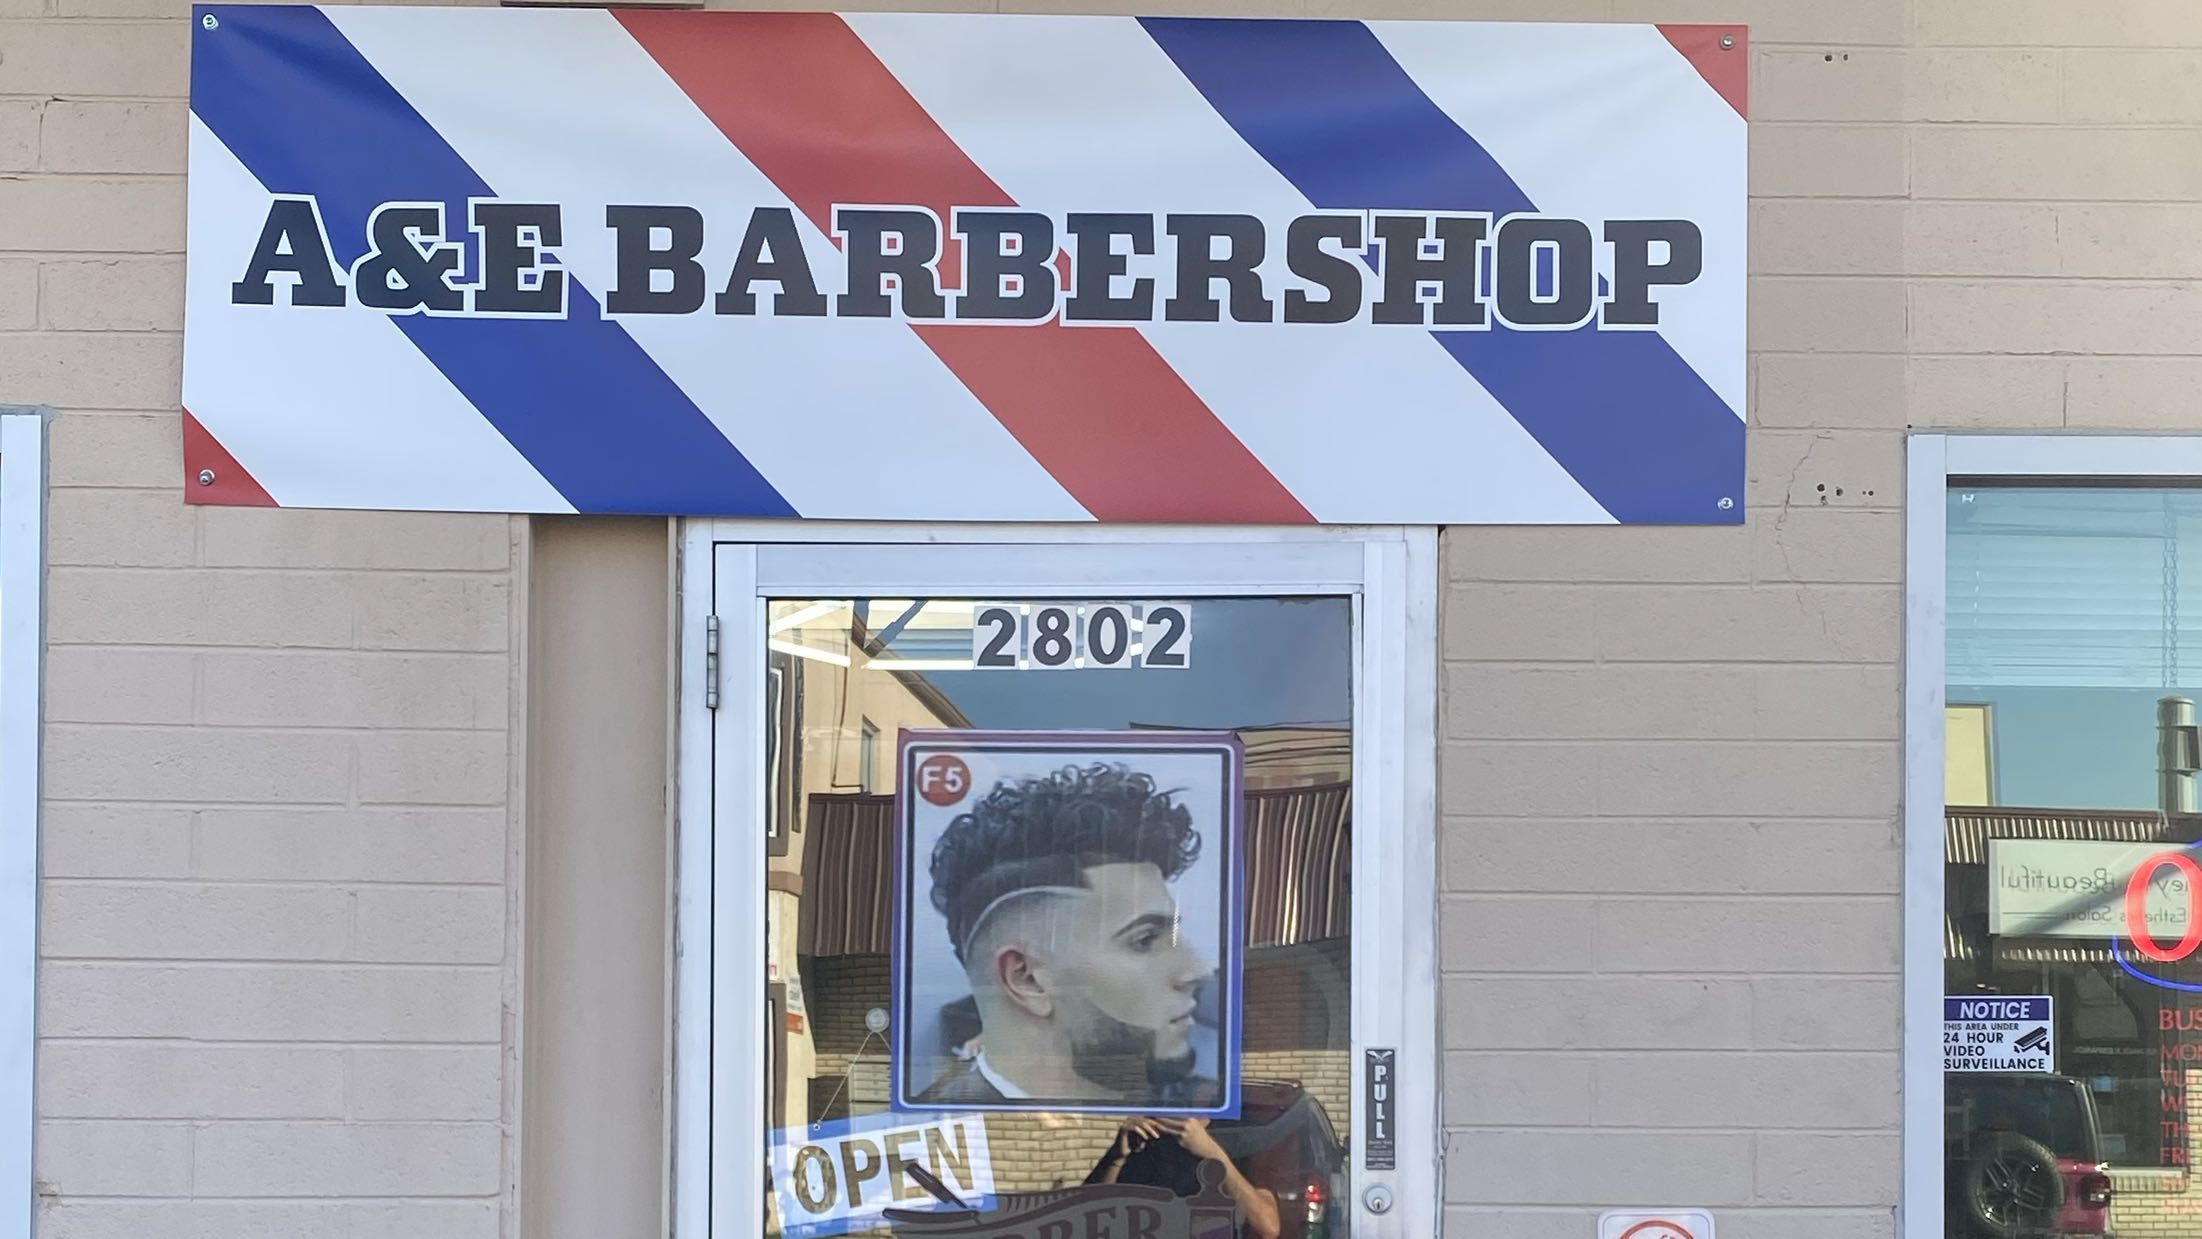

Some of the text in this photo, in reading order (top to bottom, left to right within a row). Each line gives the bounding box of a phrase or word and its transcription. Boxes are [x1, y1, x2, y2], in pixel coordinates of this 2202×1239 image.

[231, 198, 1703, 326] A&E BARBERSHOP
[975, 605, 1187, 668] 2802
[922, 766, 963, 793] F5
[1960, 1001, 2031, 1019] NOTICE
[1944, 1023, 2019, 1031] THIS AREA UNDER
[1944, 1032, 2004, 1043] 24 HOUR
[1944, 1045, 1985, 1056] VIDEO
[1944, 1058, 2045, 1069] SURVEILLANCE
[1373, 1064, 1387, 1139] PULL
[792, 1122, 975, 1215] OPEN
